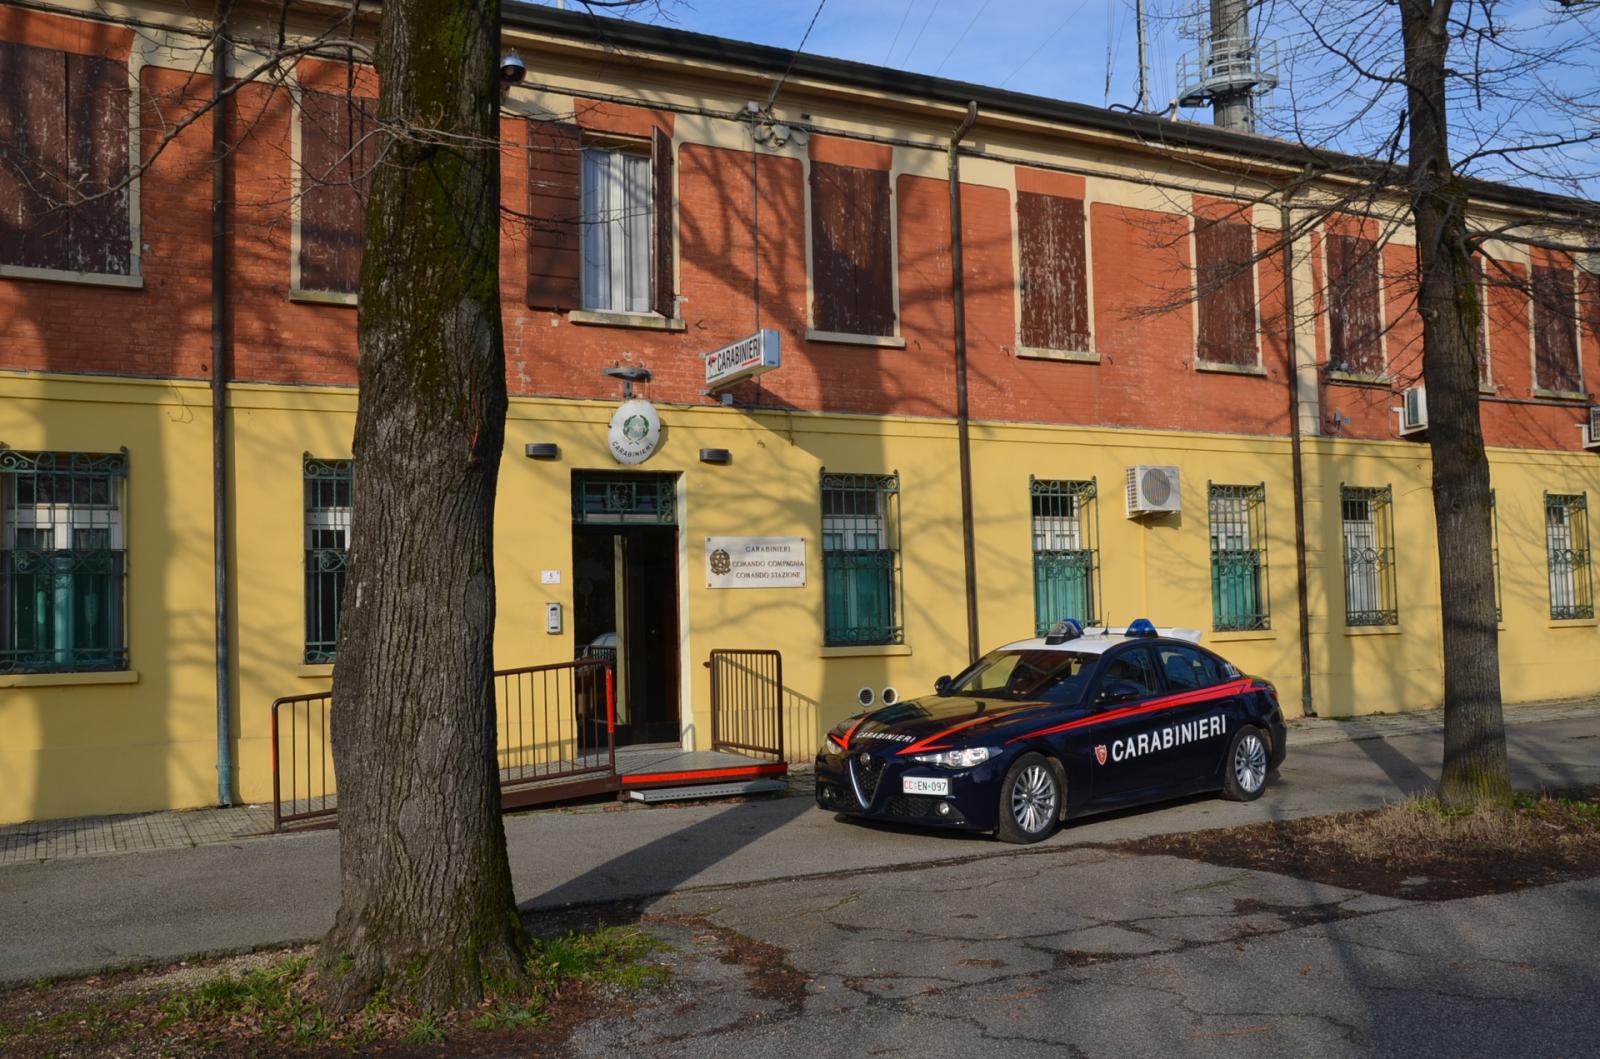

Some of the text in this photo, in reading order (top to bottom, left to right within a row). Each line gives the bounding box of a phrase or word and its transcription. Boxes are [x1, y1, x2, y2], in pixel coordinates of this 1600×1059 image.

[717, 336, 761, 372] CARABINIERI
[612, 441, 653, 457] CARABINIERI
[732, 560, 804, 568] COMANDO COMPAGNIA
[735, 571, 769, 579] COMANDO
[856, 731, 917, 743] CARABINIERI
[1111, 714, 1227, 762] CARABINIERI
